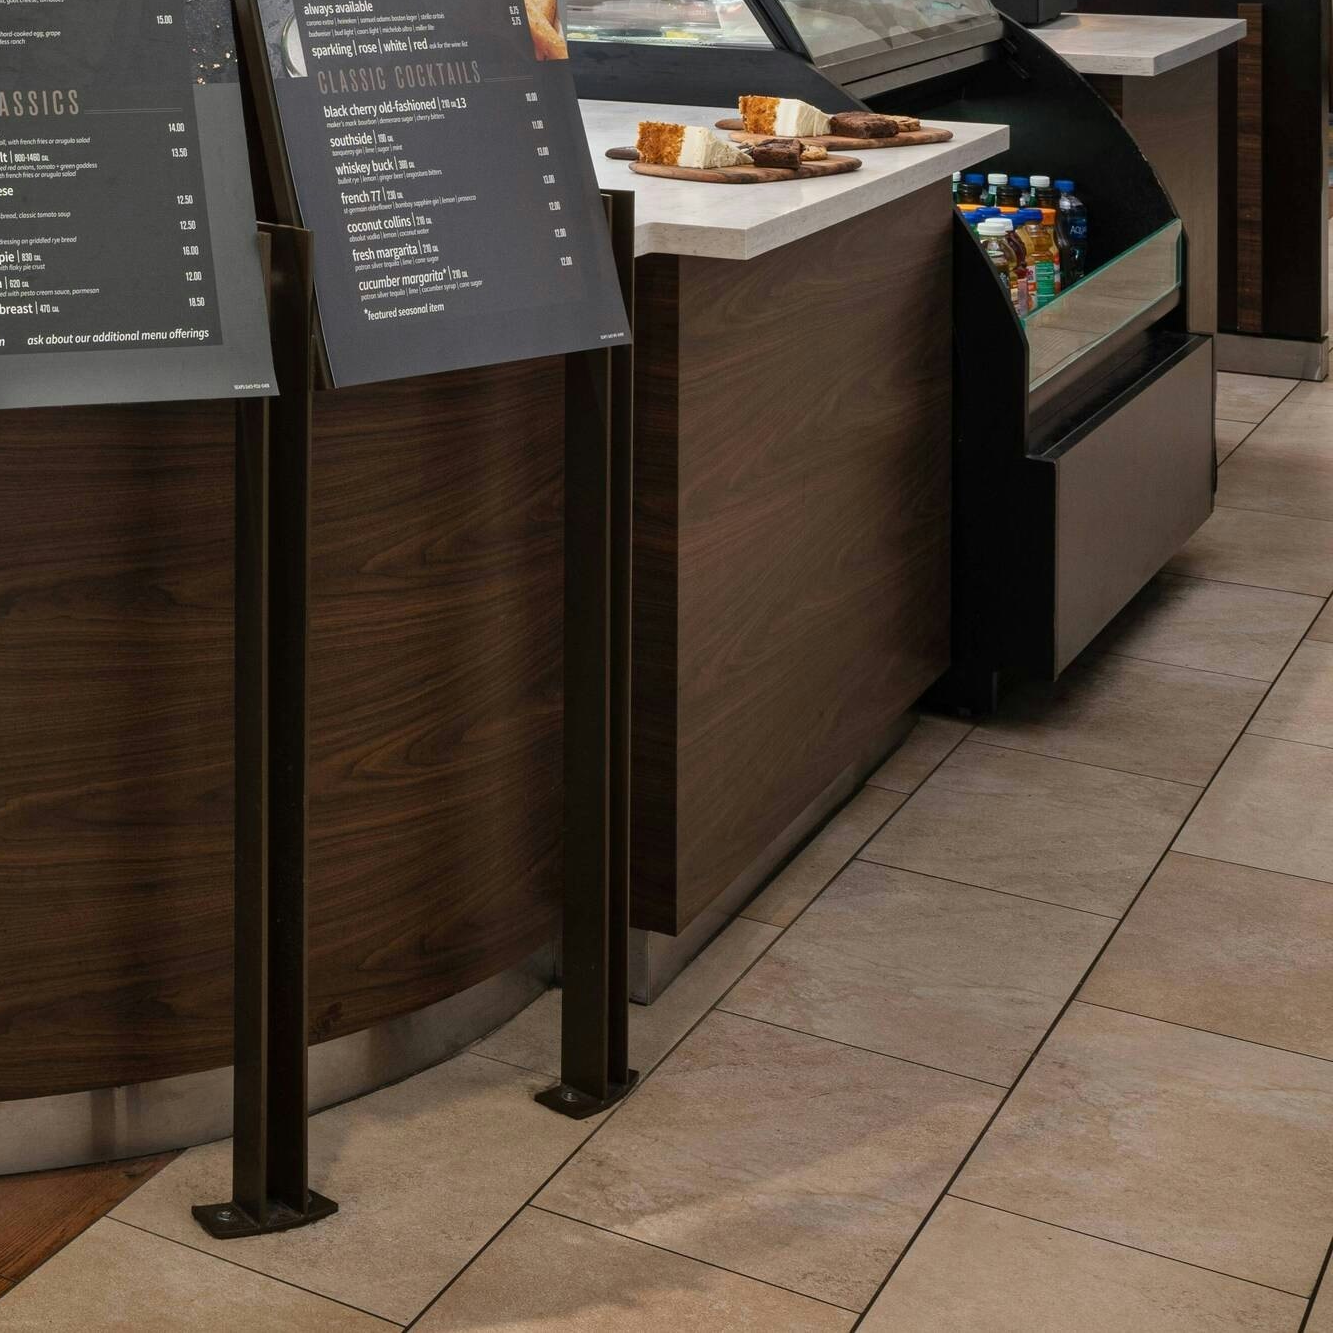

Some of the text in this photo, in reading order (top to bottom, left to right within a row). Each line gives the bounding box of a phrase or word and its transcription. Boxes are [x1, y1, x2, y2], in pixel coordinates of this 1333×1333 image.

[303, 1, 373, 16] always available
[311, 38, 428, 58] sparkling rose white red
[317, 60, 481, 95] CLASSIC COCKTAILS
[323, 99, 437, 118] black cherry old-fashioned
[330, 133, 373, 148] southside
[335, 159, 394, 176] whiskey buck
[340, 190, 370, 205] french
[347, 217, 412, 233] coconut collins
[358, 275, 401, 291] cucumber
[27, 328, 210, 346] ask about our additional menu offerings
